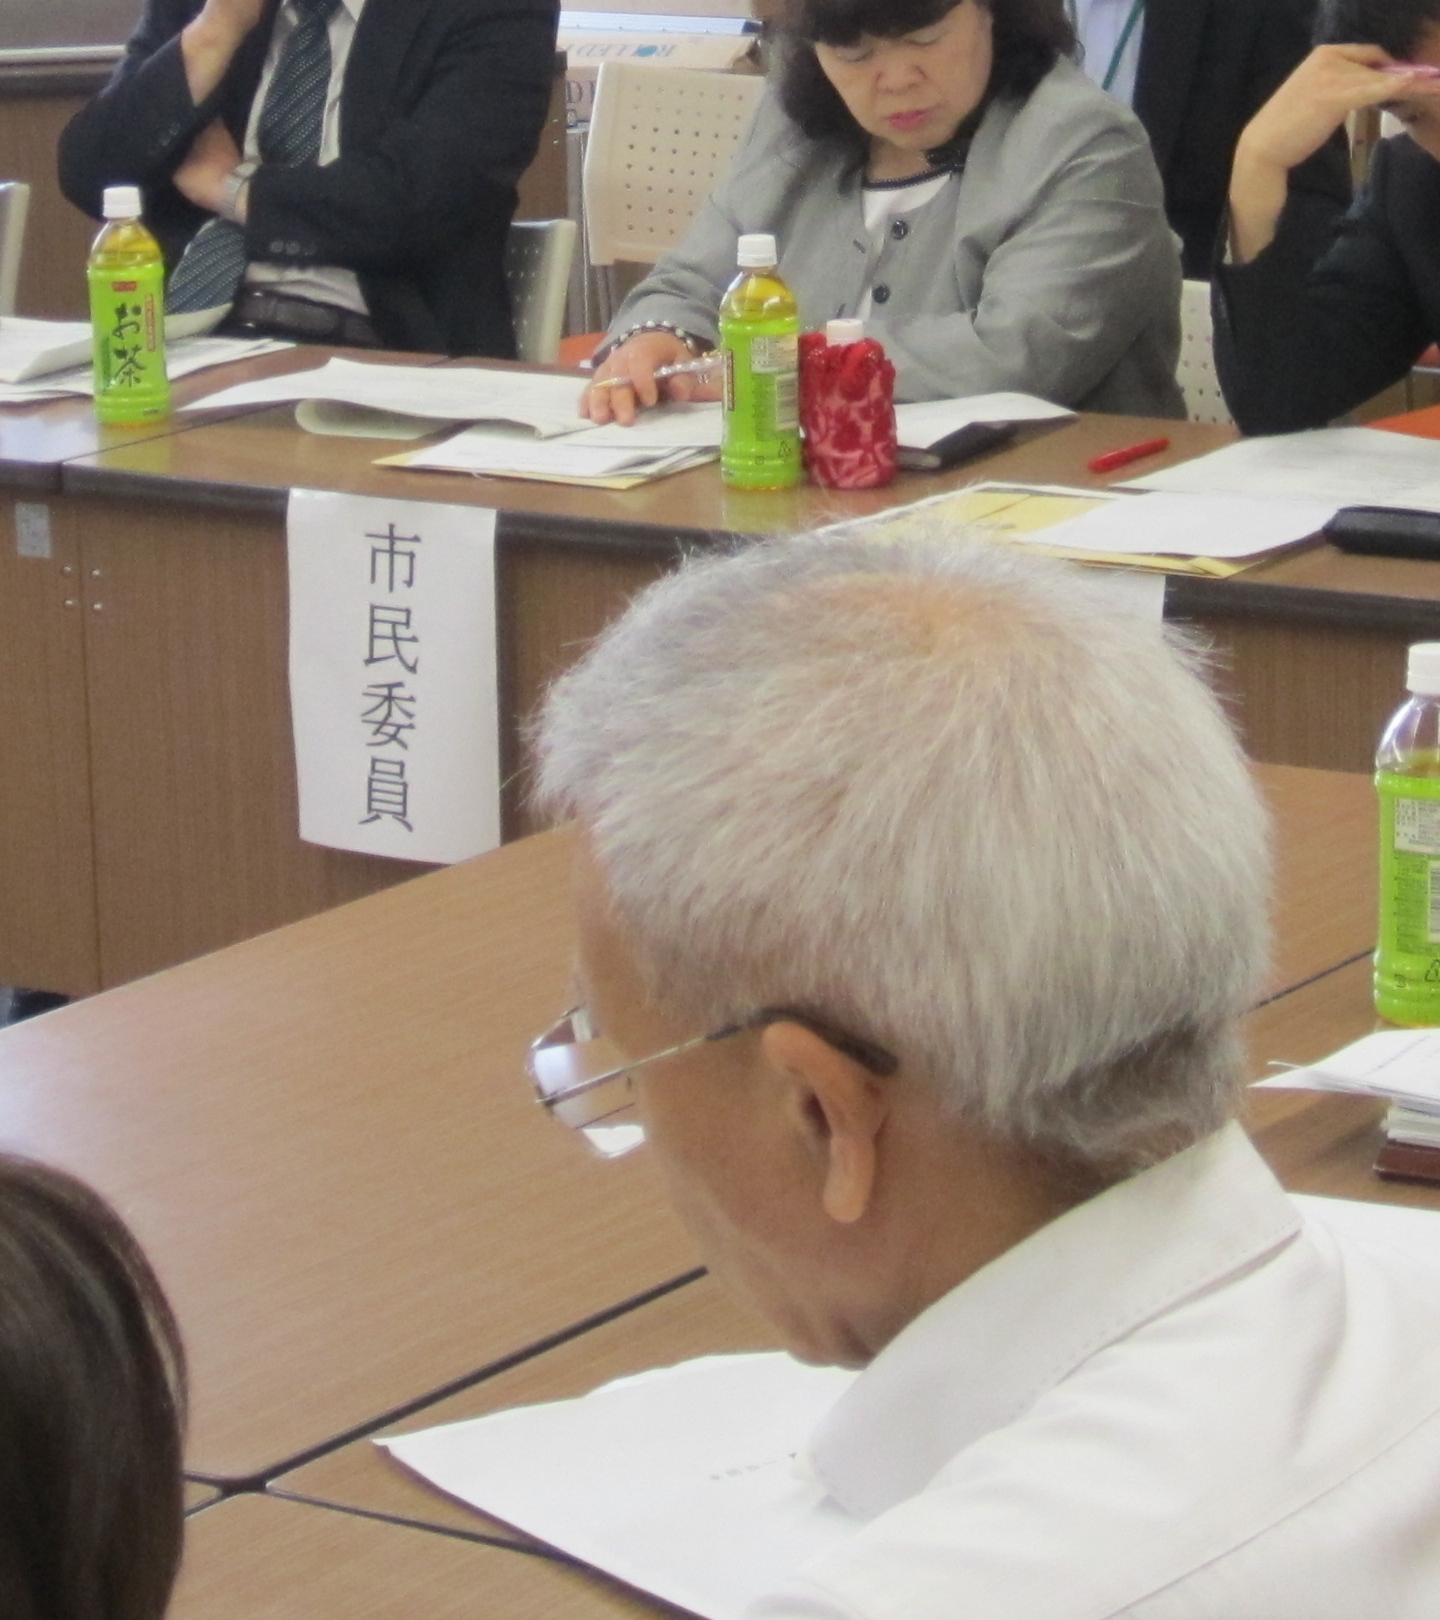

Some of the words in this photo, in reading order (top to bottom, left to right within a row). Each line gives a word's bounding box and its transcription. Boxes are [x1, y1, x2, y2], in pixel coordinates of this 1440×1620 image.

[112, 302, 147, 388] お茶
[358, 523, 422, 833] 市民委員
